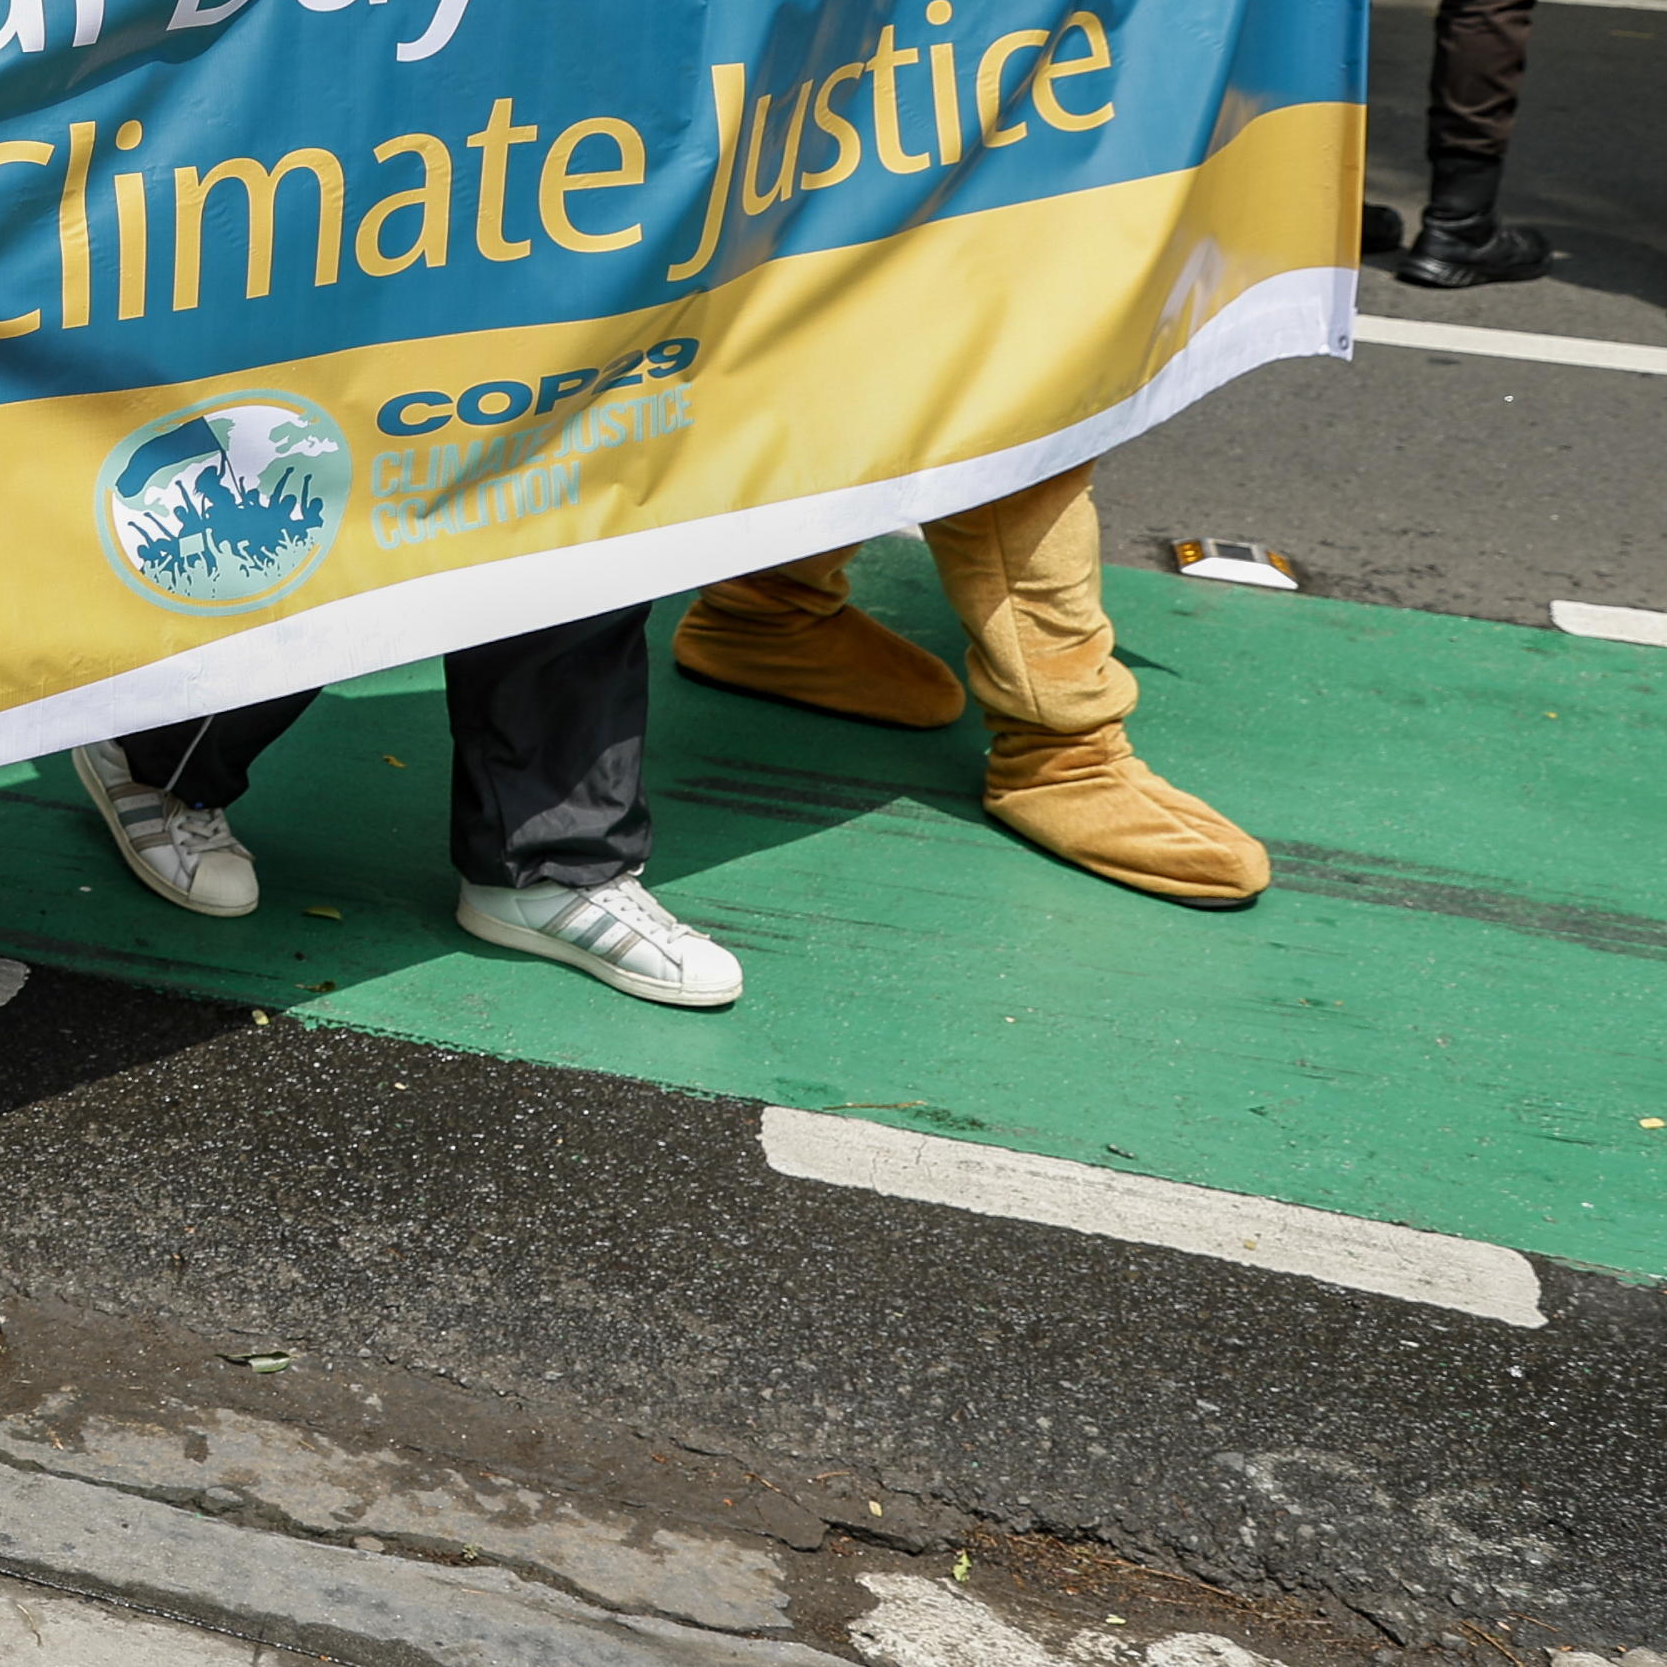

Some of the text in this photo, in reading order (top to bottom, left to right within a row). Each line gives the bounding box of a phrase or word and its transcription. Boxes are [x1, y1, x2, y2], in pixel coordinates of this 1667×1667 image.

[376, 337, 701, 437] COP29
[370, 381, 696, 499] CLIMATE JUSTICE
[370, 460, 584, 552] COALITION
